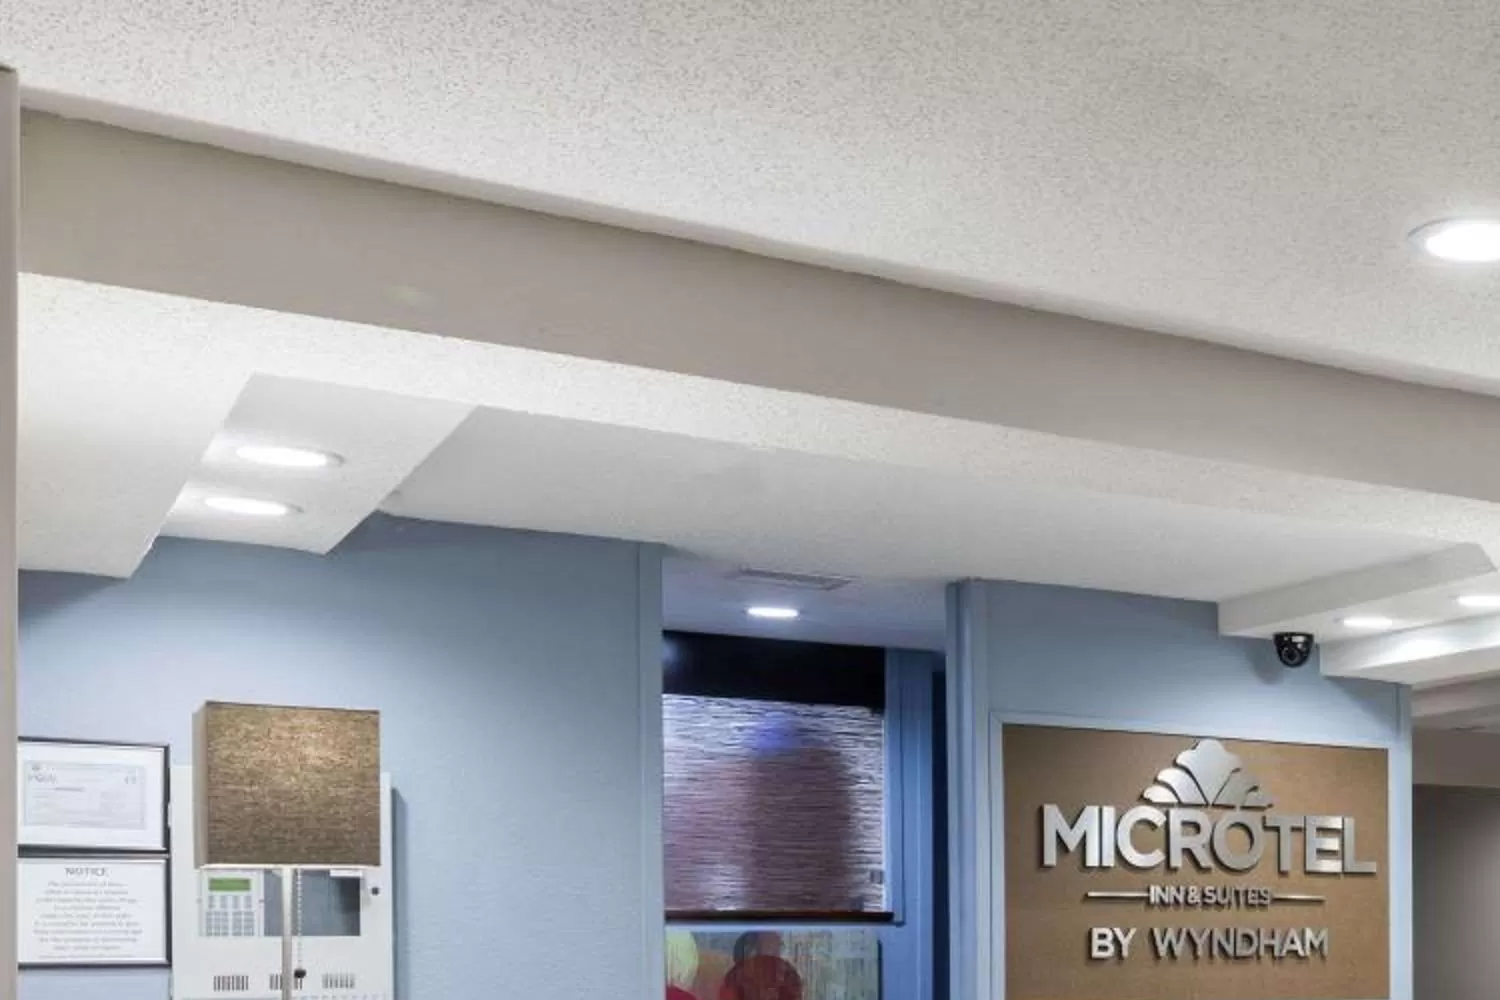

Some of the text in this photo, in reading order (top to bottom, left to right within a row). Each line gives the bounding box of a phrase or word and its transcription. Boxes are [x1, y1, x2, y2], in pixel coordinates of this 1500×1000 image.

[1042, 803, 1377, 874] MICROTEL
[1091, 927, 1329, 959] BY WYNDHAM
